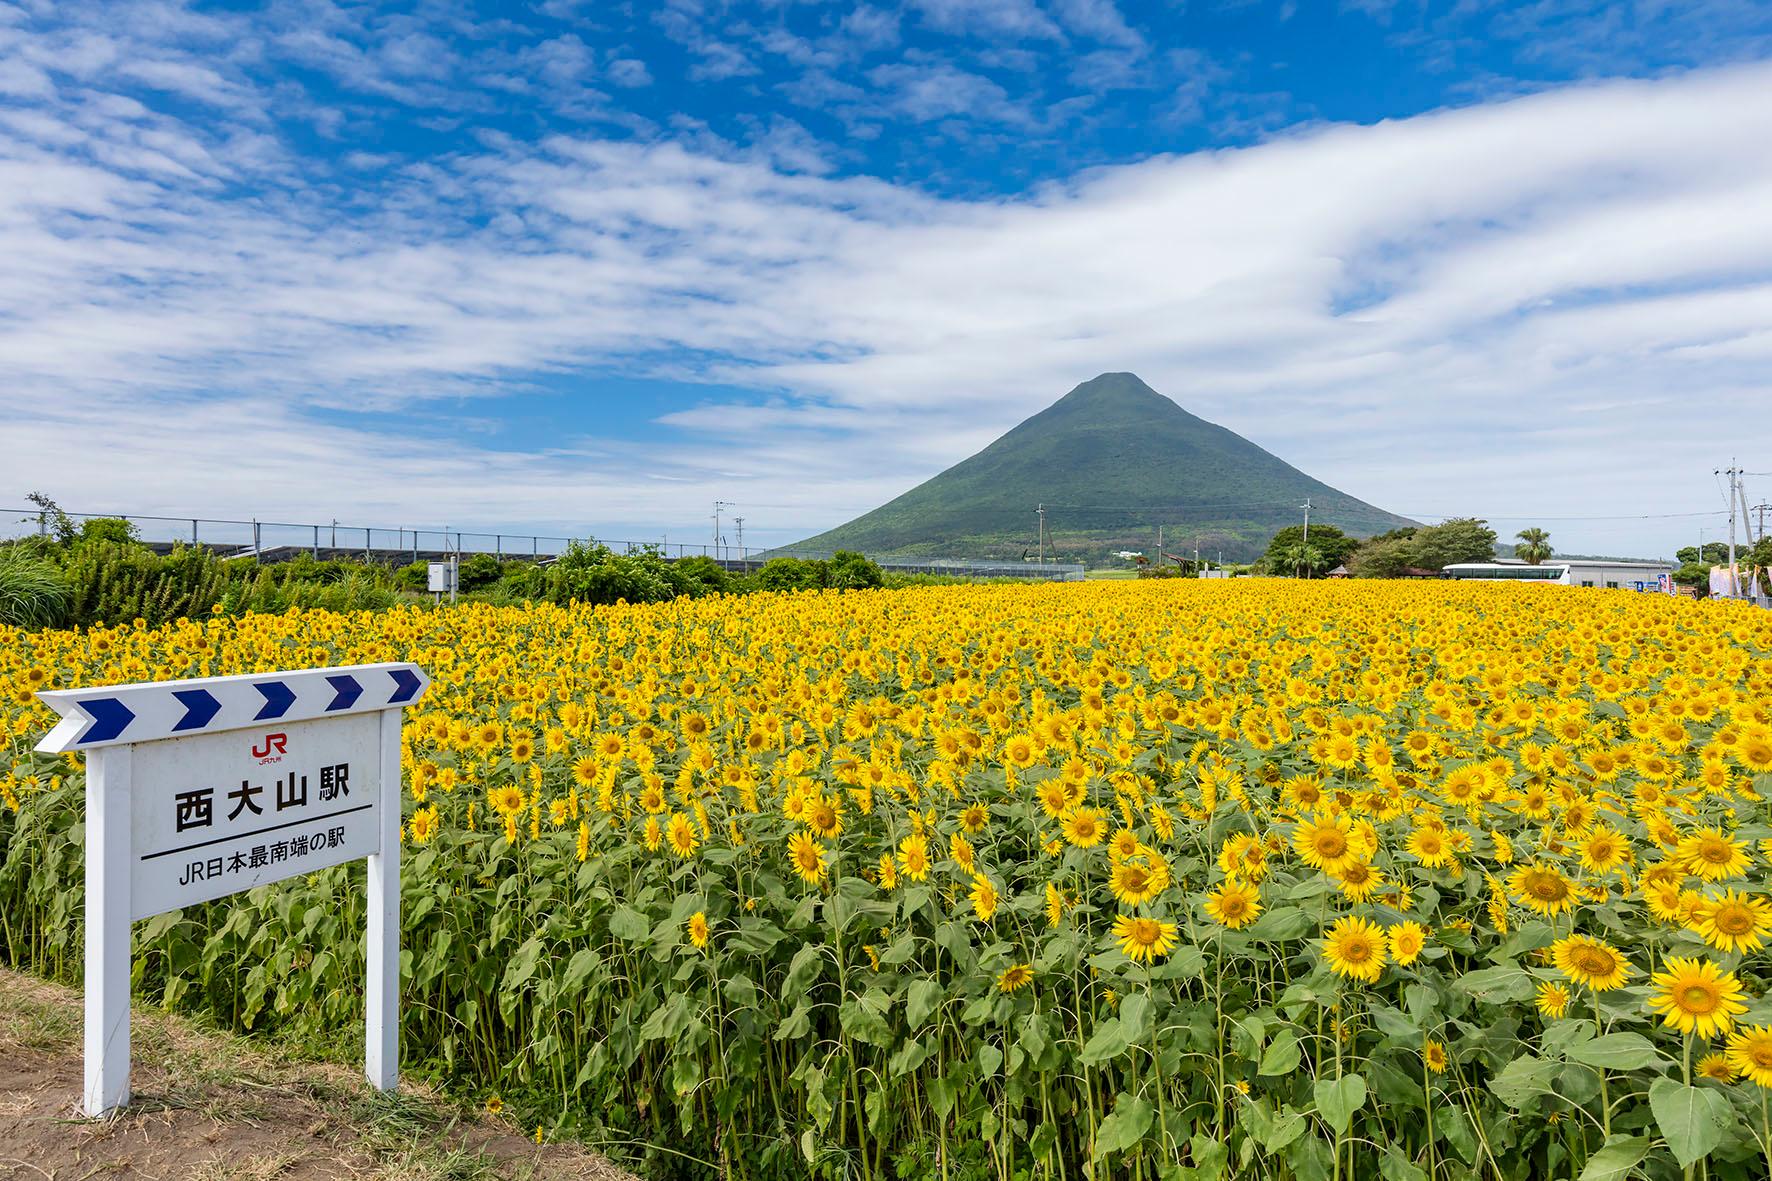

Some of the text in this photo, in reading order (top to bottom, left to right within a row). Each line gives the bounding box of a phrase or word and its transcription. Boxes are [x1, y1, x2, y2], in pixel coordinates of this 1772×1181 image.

[252, 733, 287, 758] JR
[175, 763, 349, 832] 西大山駅
[179, 826, 345, 886] JR日本最南端の駅
